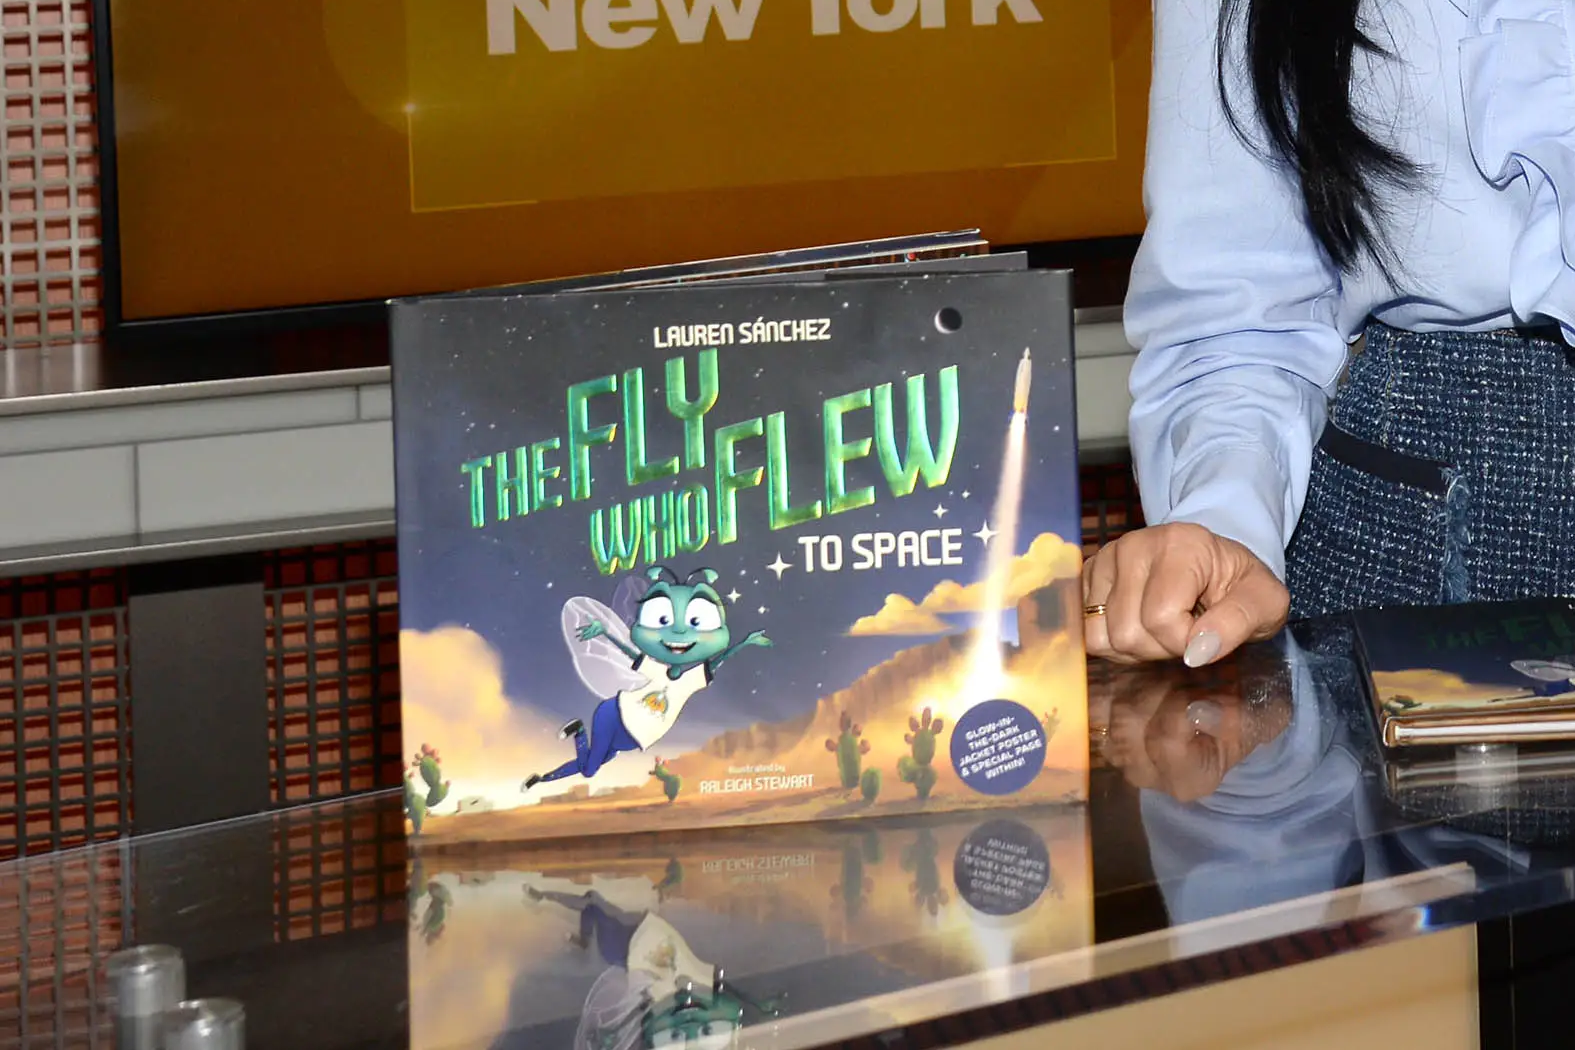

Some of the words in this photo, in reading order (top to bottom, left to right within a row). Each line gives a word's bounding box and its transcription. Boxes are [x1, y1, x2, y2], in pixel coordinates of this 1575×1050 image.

[654, 323, 734, 348] LAUREN
[739, 316, 831, 344] SÁNCHEZ
[461, 437, 562, 528] THE
[567, 348, 719, 501] FLY
[591, 485, 709, 575] WHO
[715, 365, 959, 545] FLEW
[798, 535, 841, 573] TO
[852, 528, 963, 569] SPACE
[998, 729, 1039, 751] POSTER
[700, 778, 753, 794] RALEIGH
[755, 773, 814, 790] STEWART
